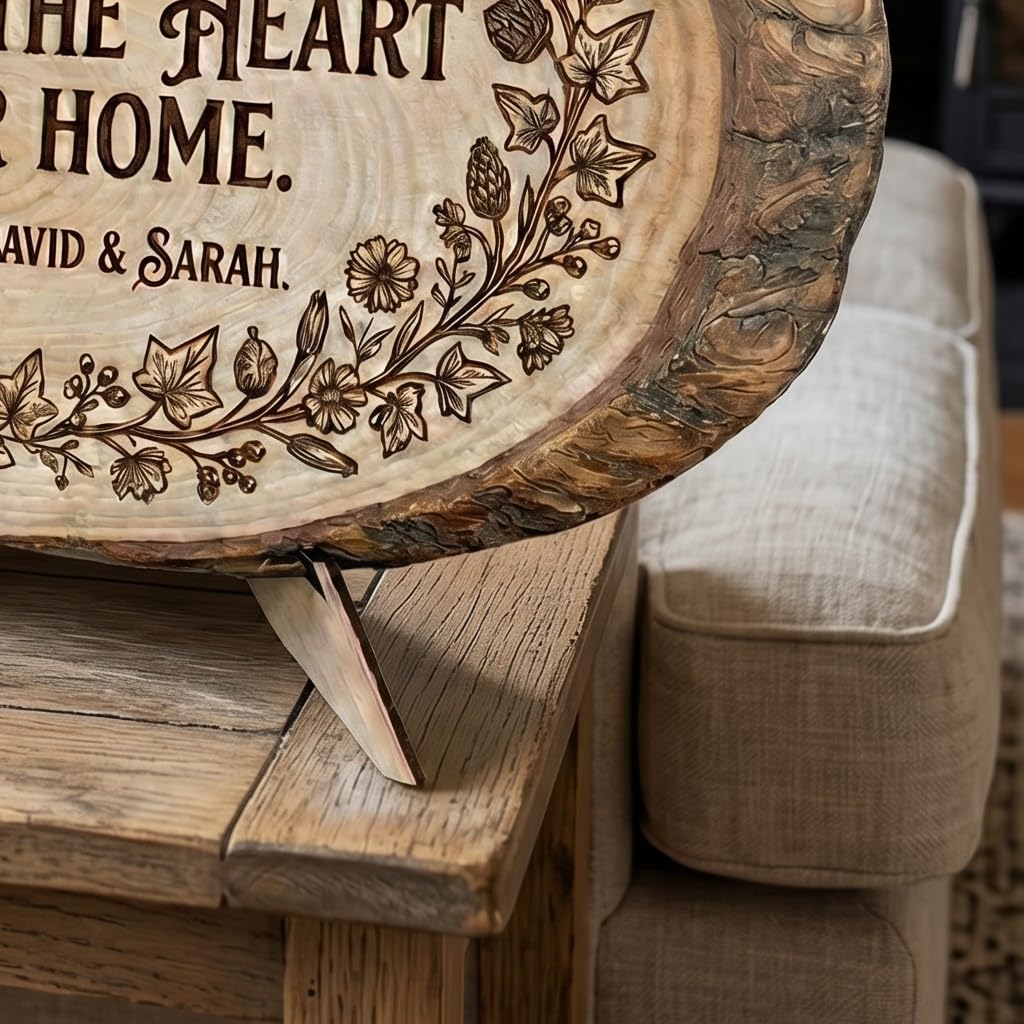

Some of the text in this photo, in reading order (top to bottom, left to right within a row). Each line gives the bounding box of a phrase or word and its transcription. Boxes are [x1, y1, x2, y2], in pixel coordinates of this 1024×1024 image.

[36, 87, 294, 193] HOME.
[98, 230, 127, 275] &
[131, 226, 291, 292] SARAH.
